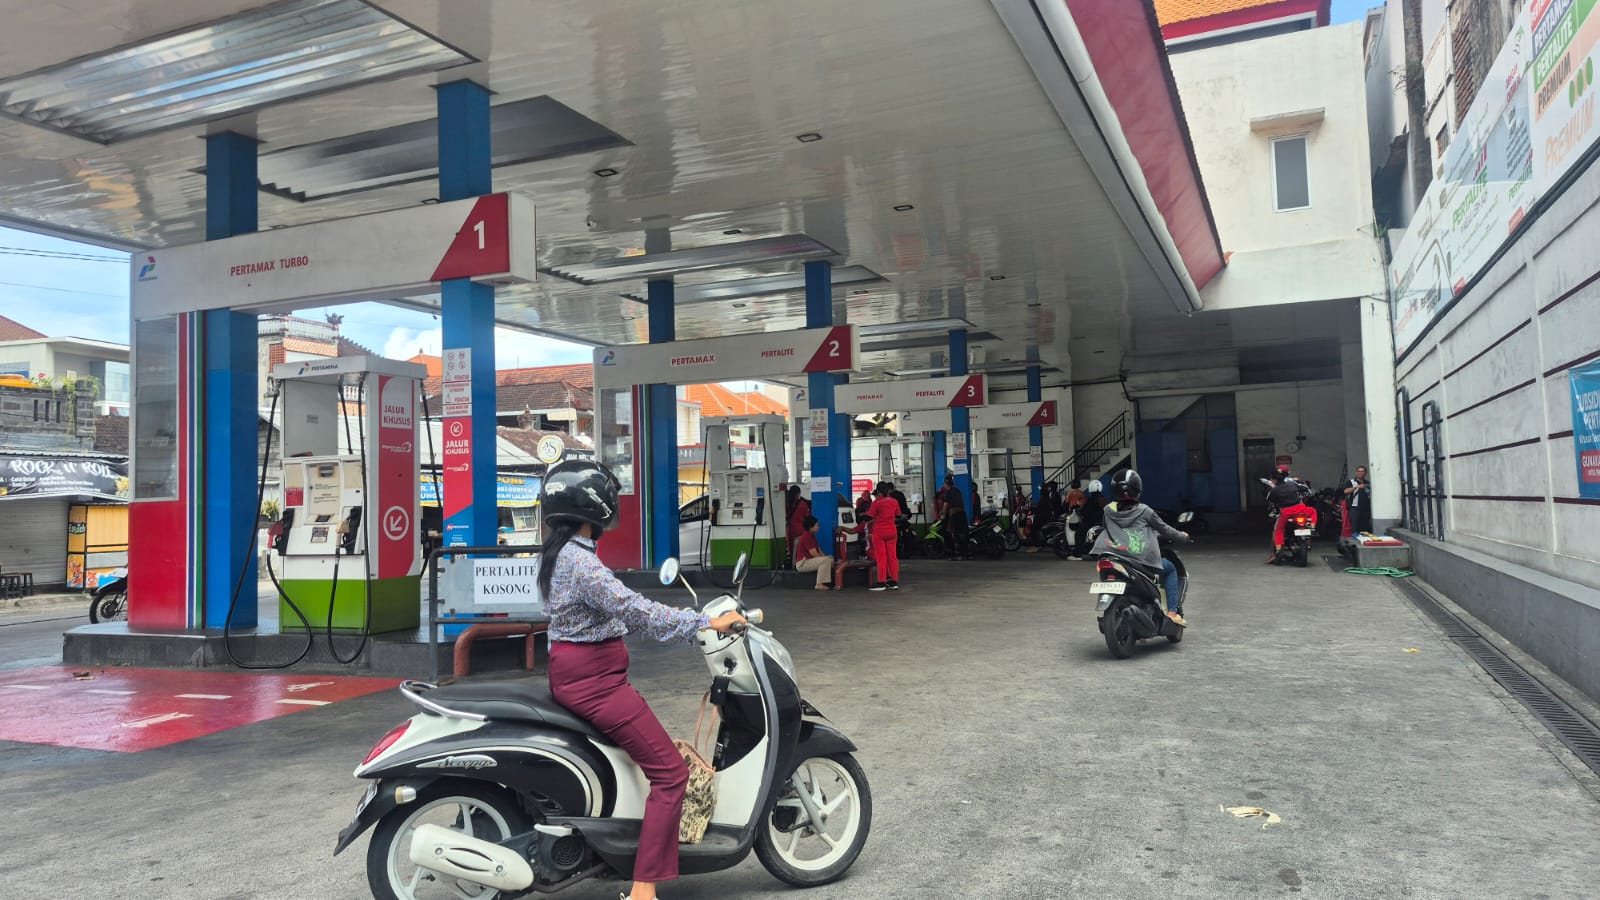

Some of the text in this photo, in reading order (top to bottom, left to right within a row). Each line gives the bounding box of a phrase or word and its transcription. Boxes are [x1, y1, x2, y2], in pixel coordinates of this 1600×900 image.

[1536, 12, 1573, 84] PERTALITE
[1538, 51, 1571, 114] PREMIUM
[1545, 91, 1594, 176] PREMIUM
[473, 220, 485, 250] 1
[230, 255, 309, 277] PERTAMAX TURBO
[828, 340, 840, 357] 2
[671, 348, 795, 366] PERTAMAX PERTALITE
[916, 389, 945, 397] PERTALITE
[967, 385, 975, 398] 3
[384, 405, 405, 415] JALUR
[1040, 408, 1048, 418] 4
[383, 415, 412, 426] KHUSUS
[445, 439, 469, 448] JALUR
[445, 447, 470, 455] KHUSUS
[10, 459, 64, 475] ROCK
[81, 461, 121, 479] ROLL
[475, 565, 537, 577] PERTALITE
[483, 583, 531, 595] KOSONG
